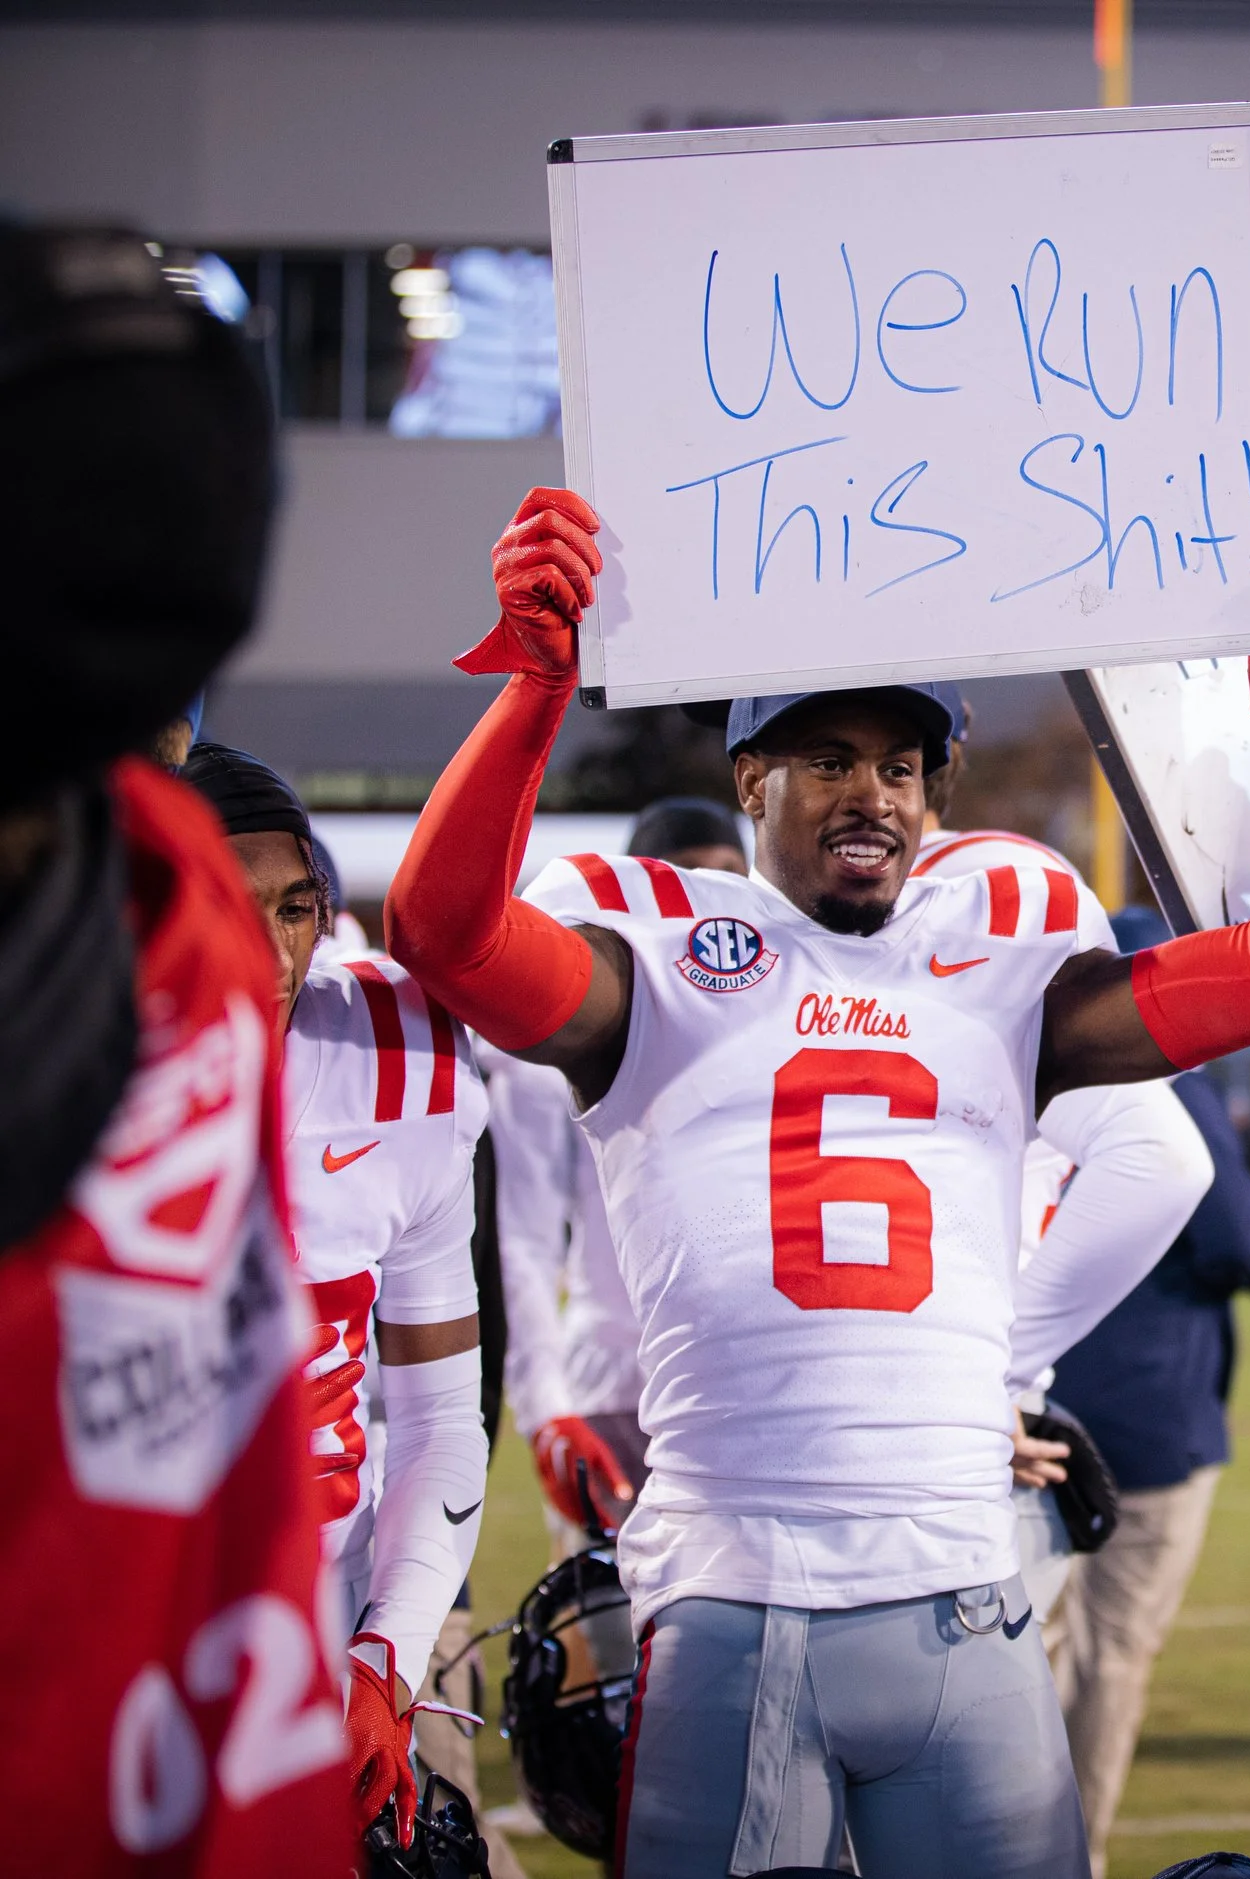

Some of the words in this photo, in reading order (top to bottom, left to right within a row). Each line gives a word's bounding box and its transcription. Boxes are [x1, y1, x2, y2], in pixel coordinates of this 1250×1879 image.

[704, 243, 967, 419] We
[695, 920, 757, 970] SEC
[689, 963, 767, 990] GRADUATE
[796, 992, 840, 1037] Ole
[840, 997, 912, 1040] Miss
[769, 1047, 938, 1314] 6
